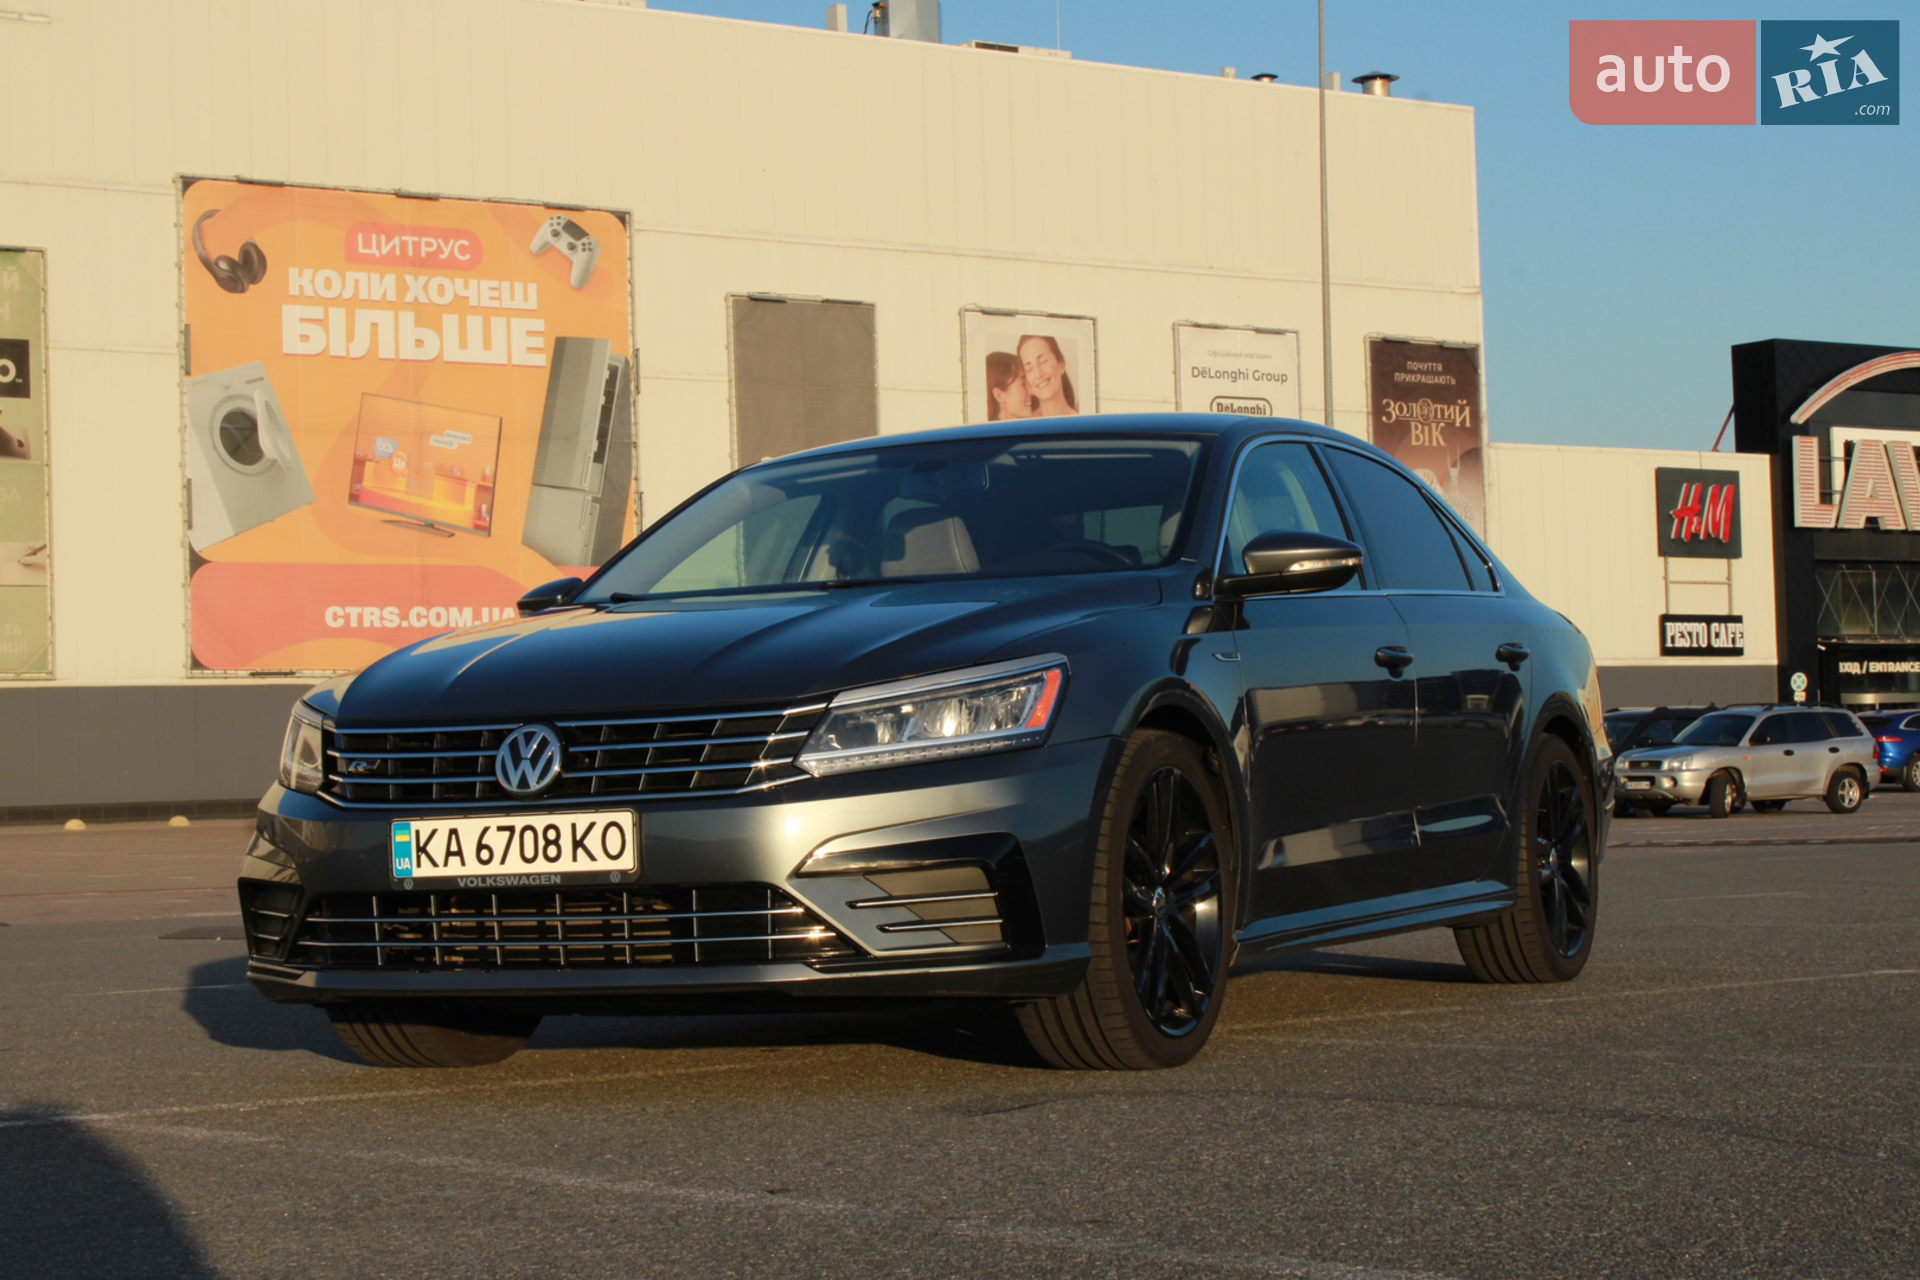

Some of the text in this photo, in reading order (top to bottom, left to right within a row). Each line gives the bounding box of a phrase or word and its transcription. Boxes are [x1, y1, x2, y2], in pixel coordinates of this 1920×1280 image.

[357, 232, 472, 261] ЦИТРУС
[288, 267, 538, 311] КОЛИ ХОЧЕШ
[281, 303, 547, 367] БІЛЬШЕ
[1252, 370, 1288, 385] Group
[1394, 373, 1456, 385] ПРИКРАШАЮТЬ
[1407, 361, 1443, 372] ПОЧУТТЯ
[1410, 422, 1447, 447] ВІК
[1670, 483, 1735, 543] H&M
[1665, 622, 1744, 648] PESTO CAFE
[1868, 661, 1920, 673] ENTRANCE
[415, 820, 627, 868] KA 6708 KO
[396, 857, 411, 870] UA
[457, 874, 561, 888] VOLKSWAGEN
